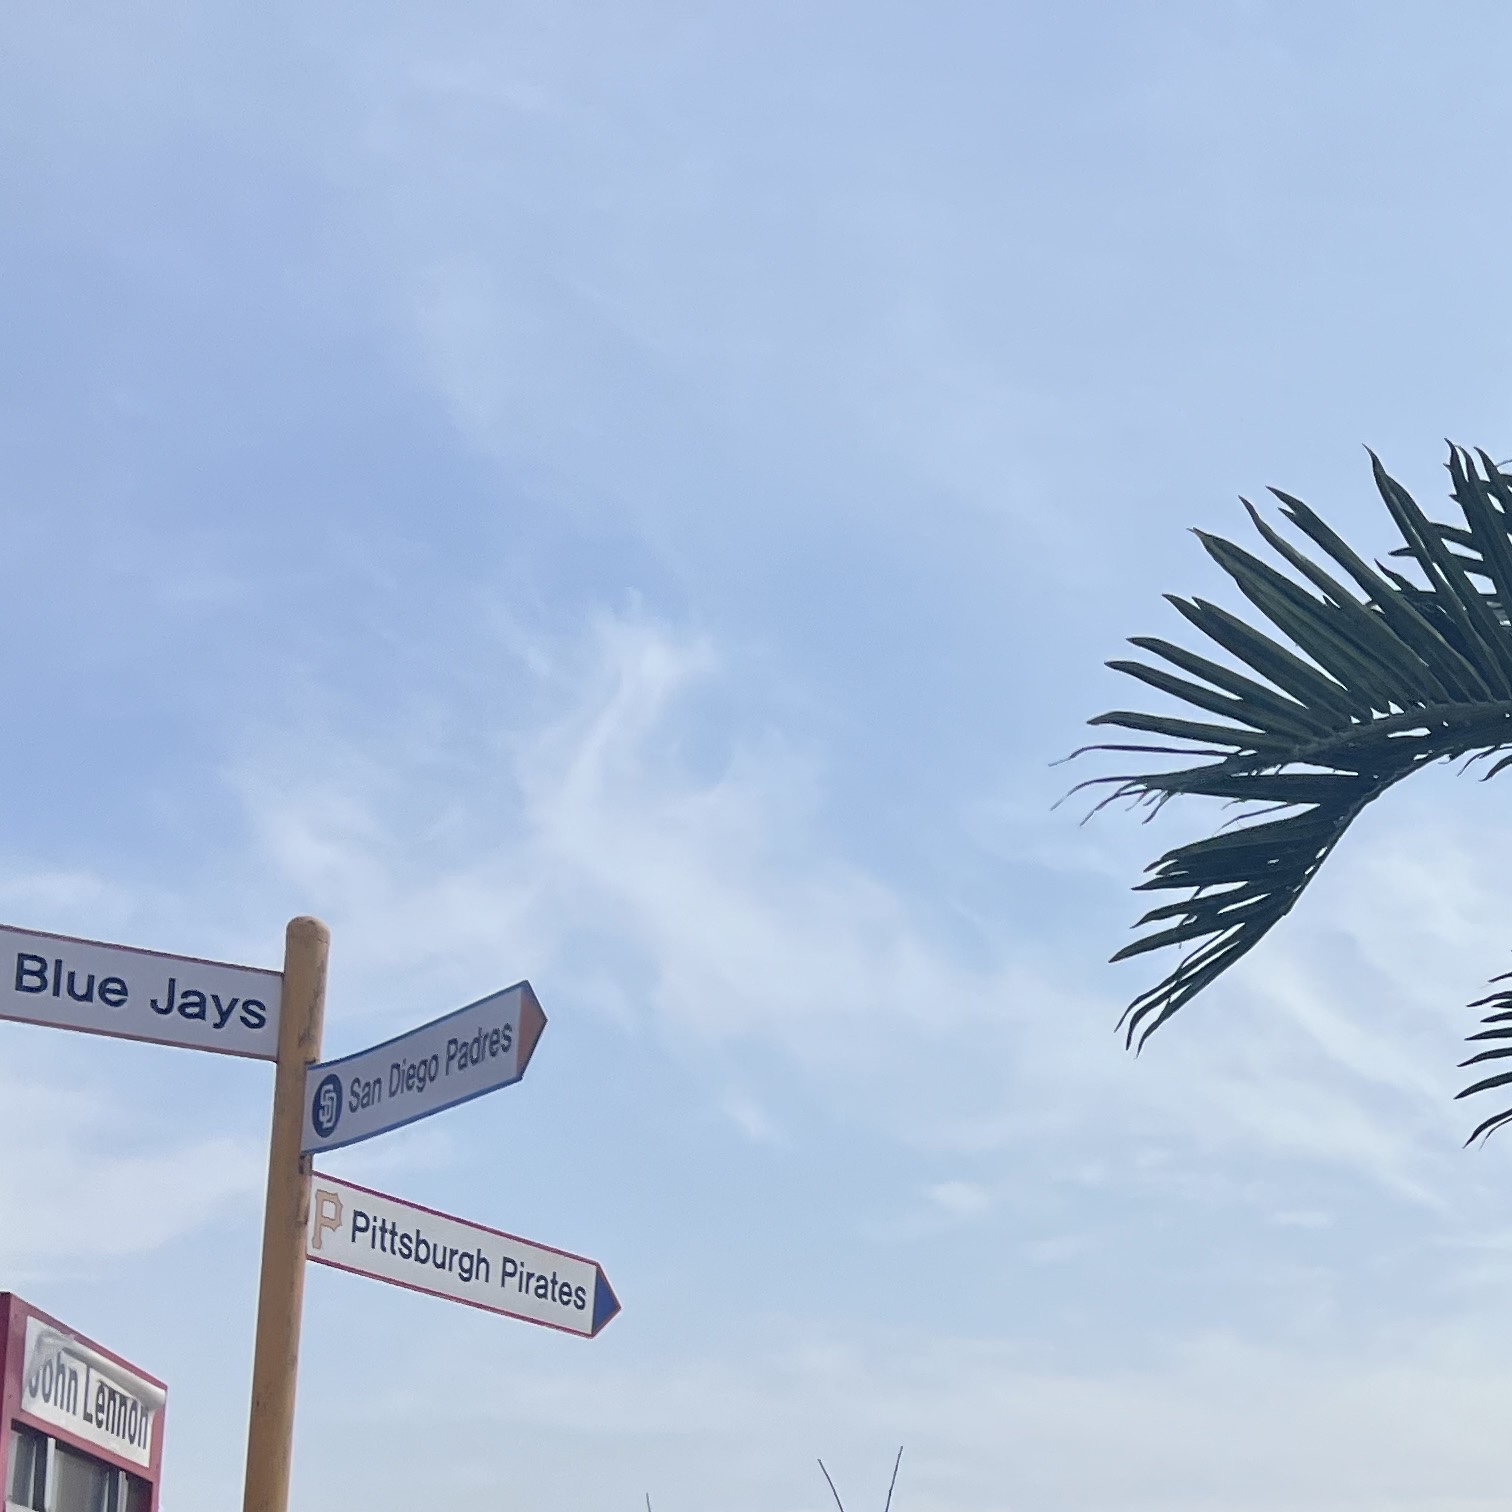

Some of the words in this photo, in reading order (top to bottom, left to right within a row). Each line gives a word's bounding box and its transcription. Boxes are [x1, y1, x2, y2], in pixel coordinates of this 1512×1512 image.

[15, 952, 129, 1008] Blue
[150, 977, 267, 1030] Jays
[349, 1076, 383, 1113] San
[389, 1053, 439, 1098] Diego
[446, 1022, 513, 1076] Padres
[312, 1188, 343, 1250] P
[352, 1209, 490, 1283] Pittsburgh
[501, 1255, 587, 1311] Pirates
[28, 1346, 79, 1416] John
[83, 1366, 149, 1450] Lennon
